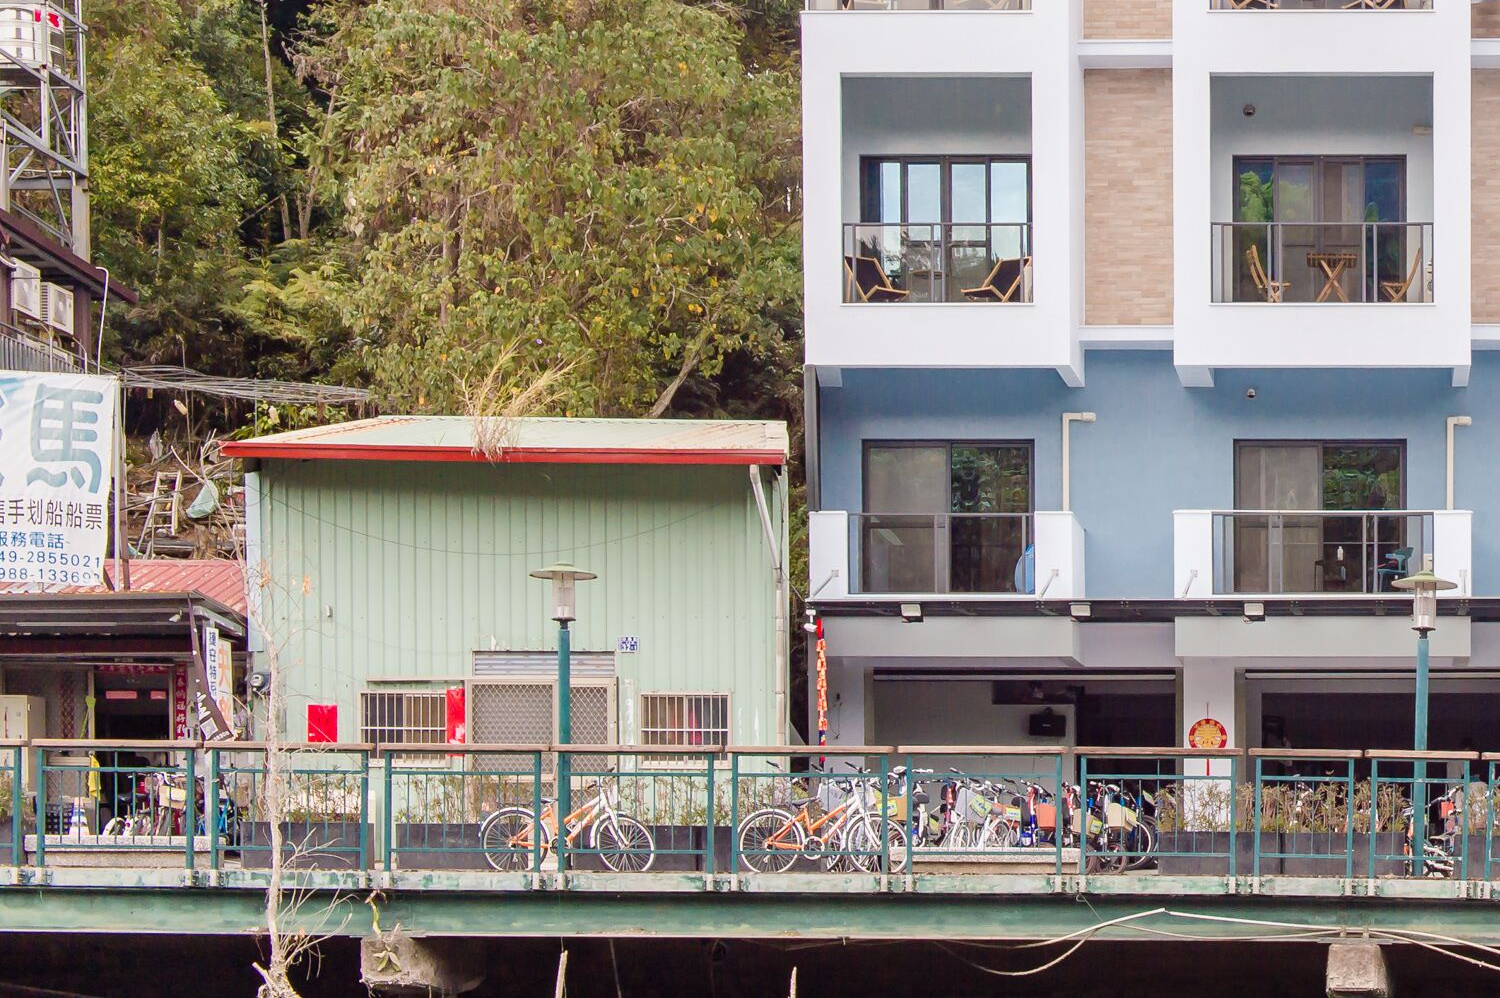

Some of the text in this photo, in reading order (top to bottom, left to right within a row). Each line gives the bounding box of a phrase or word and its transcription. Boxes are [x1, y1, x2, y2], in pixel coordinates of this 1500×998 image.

[0, 383, 103, 494] 馬
[0, 498, 102, 530] 手划船船票
